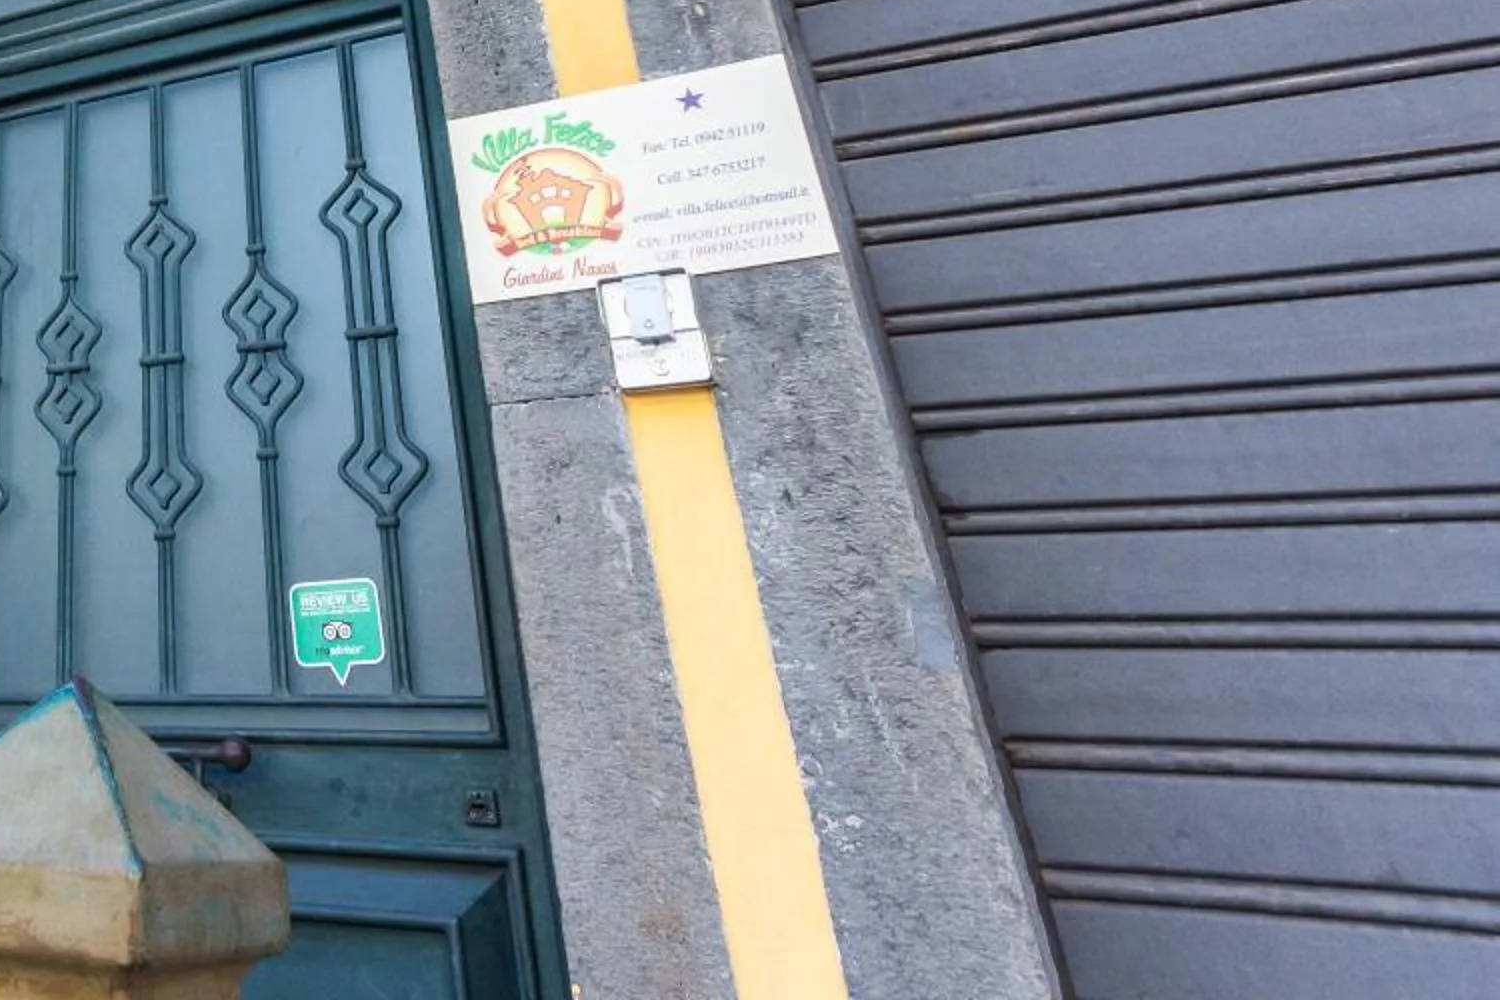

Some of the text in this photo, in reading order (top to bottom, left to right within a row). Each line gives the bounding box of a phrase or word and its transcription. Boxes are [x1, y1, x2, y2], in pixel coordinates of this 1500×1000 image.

[472, 112, 616, 173] Villa Felice
[503, 255, 618, 288] Giardini Naxos
